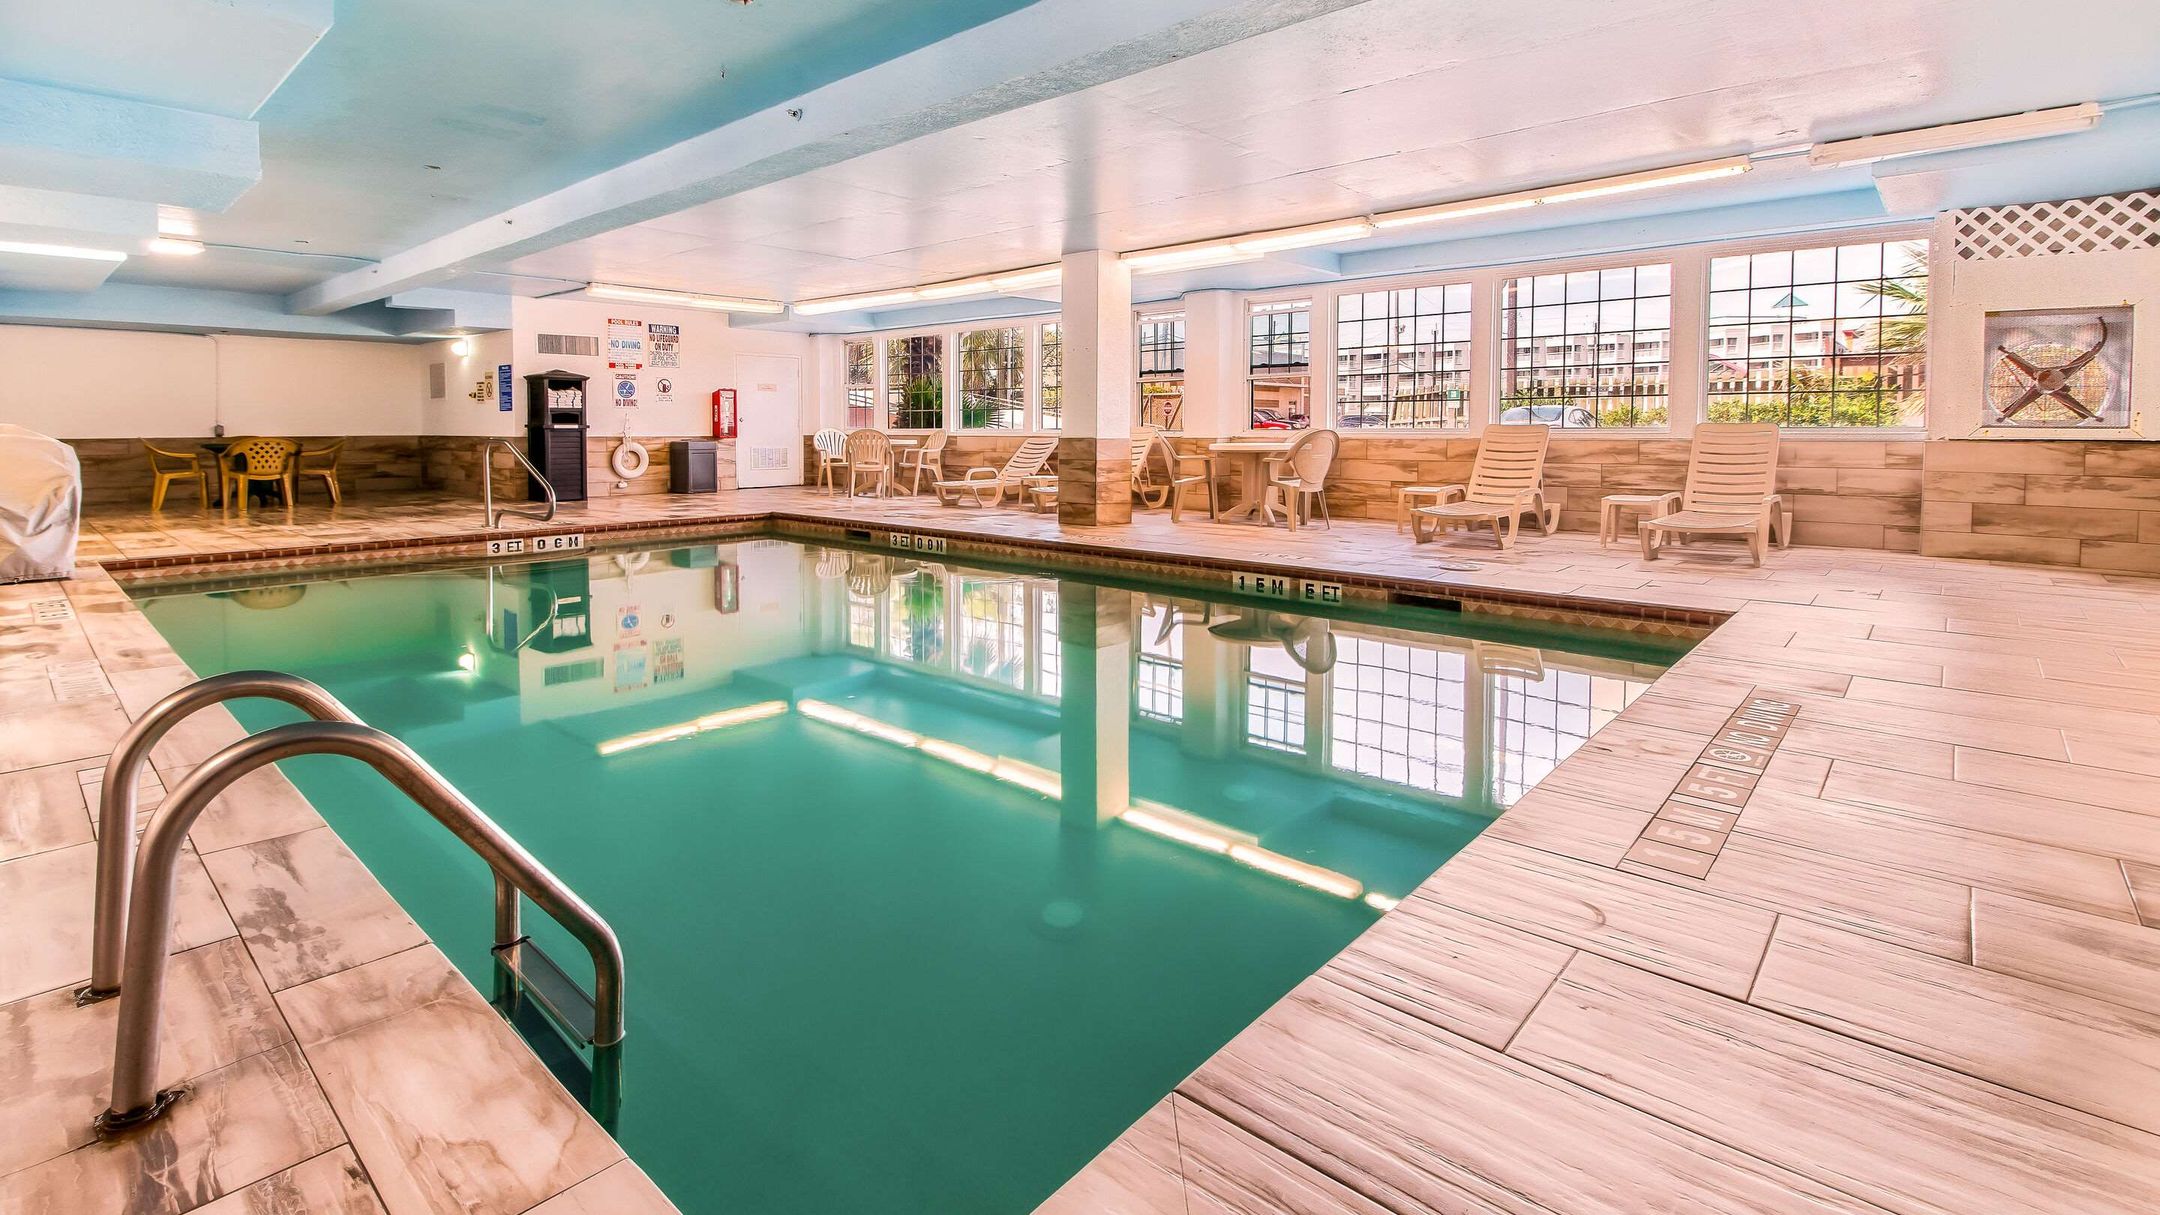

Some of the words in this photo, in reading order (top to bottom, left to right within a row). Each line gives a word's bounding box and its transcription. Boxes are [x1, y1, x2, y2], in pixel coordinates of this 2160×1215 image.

[650, 325, 677, 334] WARNING
[649, 334, 655, 342] NO
[656, 335, 679, 343] LIFEGUARD
[611, 340, 619, 348] NO
[622, 340, 641, 350] DIVING
[662, 343, 674, 351] DUTY
[1724, 731, 1771, 748] NO
